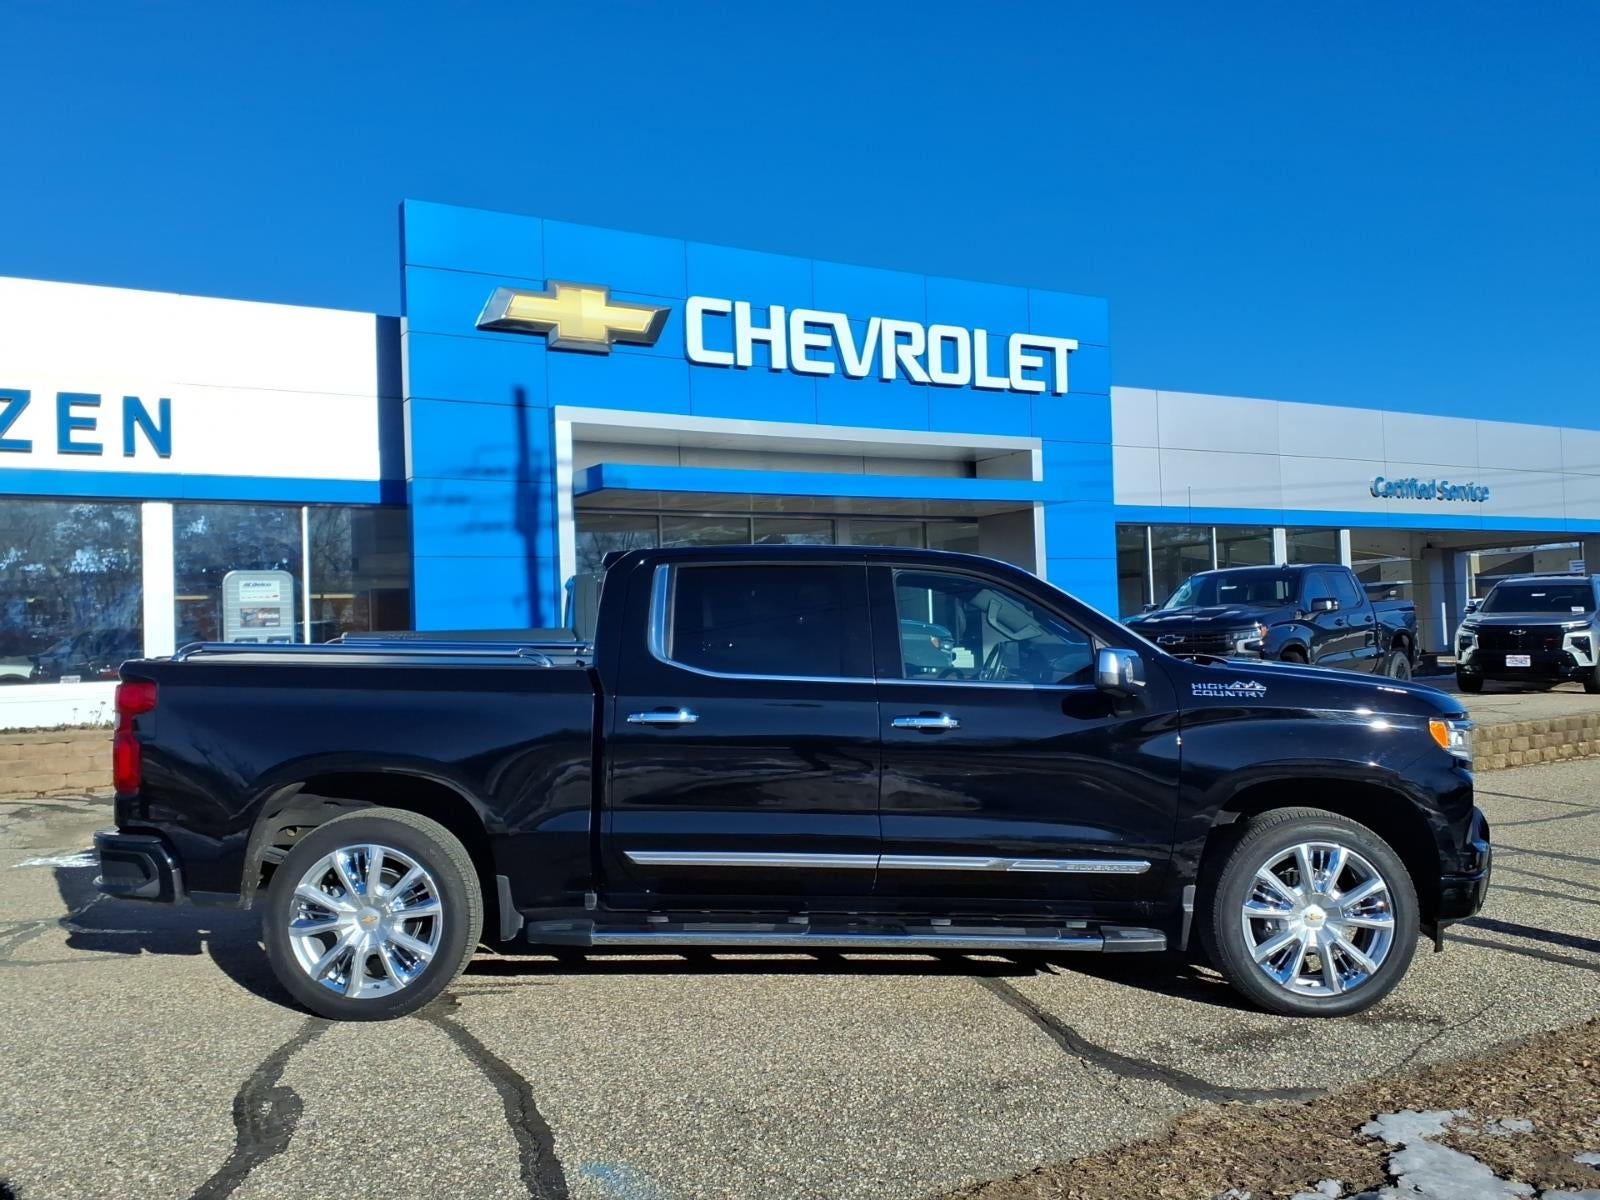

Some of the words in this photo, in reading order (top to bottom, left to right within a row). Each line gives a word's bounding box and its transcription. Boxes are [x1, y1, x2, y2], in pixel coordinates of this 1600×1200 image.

[685, 295, 1078, 394] CHEVROLET
[0, 388, 171, 459] ZEN
[1370, 476, 1436, 500] Certified
[1436, 480, 1489, 503] Service
[1192, 689, 1266, 698] COUNTRY
